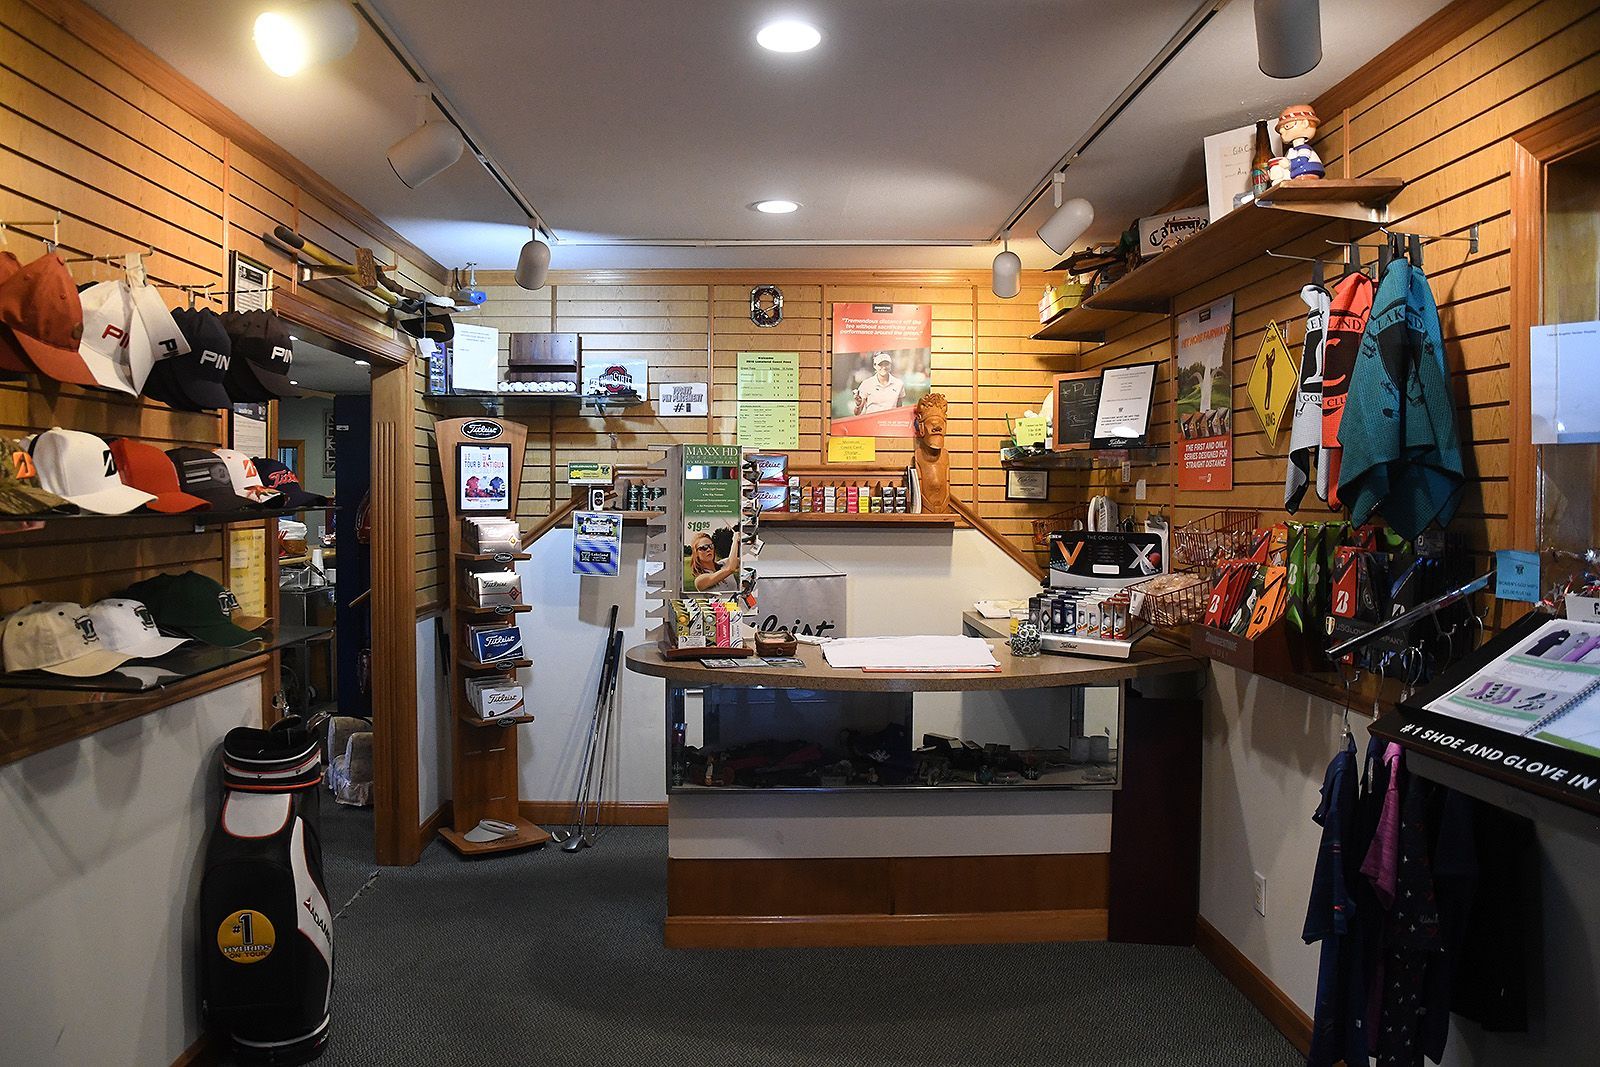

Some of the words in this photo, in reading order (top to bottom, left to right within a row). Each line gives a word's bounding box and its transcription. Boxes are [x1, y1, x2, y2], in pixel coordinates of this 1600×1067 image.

[466, 424, 498, 434] Titleist
[686, 446, 720, 456] MAXX
[722, 446, 738, 457] HD
[1186, 444, 1194, 452] THE
[1194, 443, 1206, 451] FIRST
[1206, 441, 1214, 450] AND
[1215, 440, 1227, 449] ONLY
[1184, 452, 1199, 460] SERIES
[1199, 450, 1218, 460] DESIGNED
[1219, 449, 1228, 458] FOR
[1186, 460, 1205, 469] STRAIGHT
[1205, 459, 1226, 468] DISTANCE
[1056, 541, 1085, 566] V
[1128, 543, 1155, 569] X
[484, 635, 515, 647] Titleist
[488, 693, 517, 704] Titleist
[1400, 723, 1423, 736] #1
[1420, 729, 1466, 750] SHOE
[1462, 743, 1504, 761] AND
[1503, 755, 1569, 781] GLOVE
[1567, 774, 1598, 790] IN
[223, 945, 273, 953] HYBRIDS
